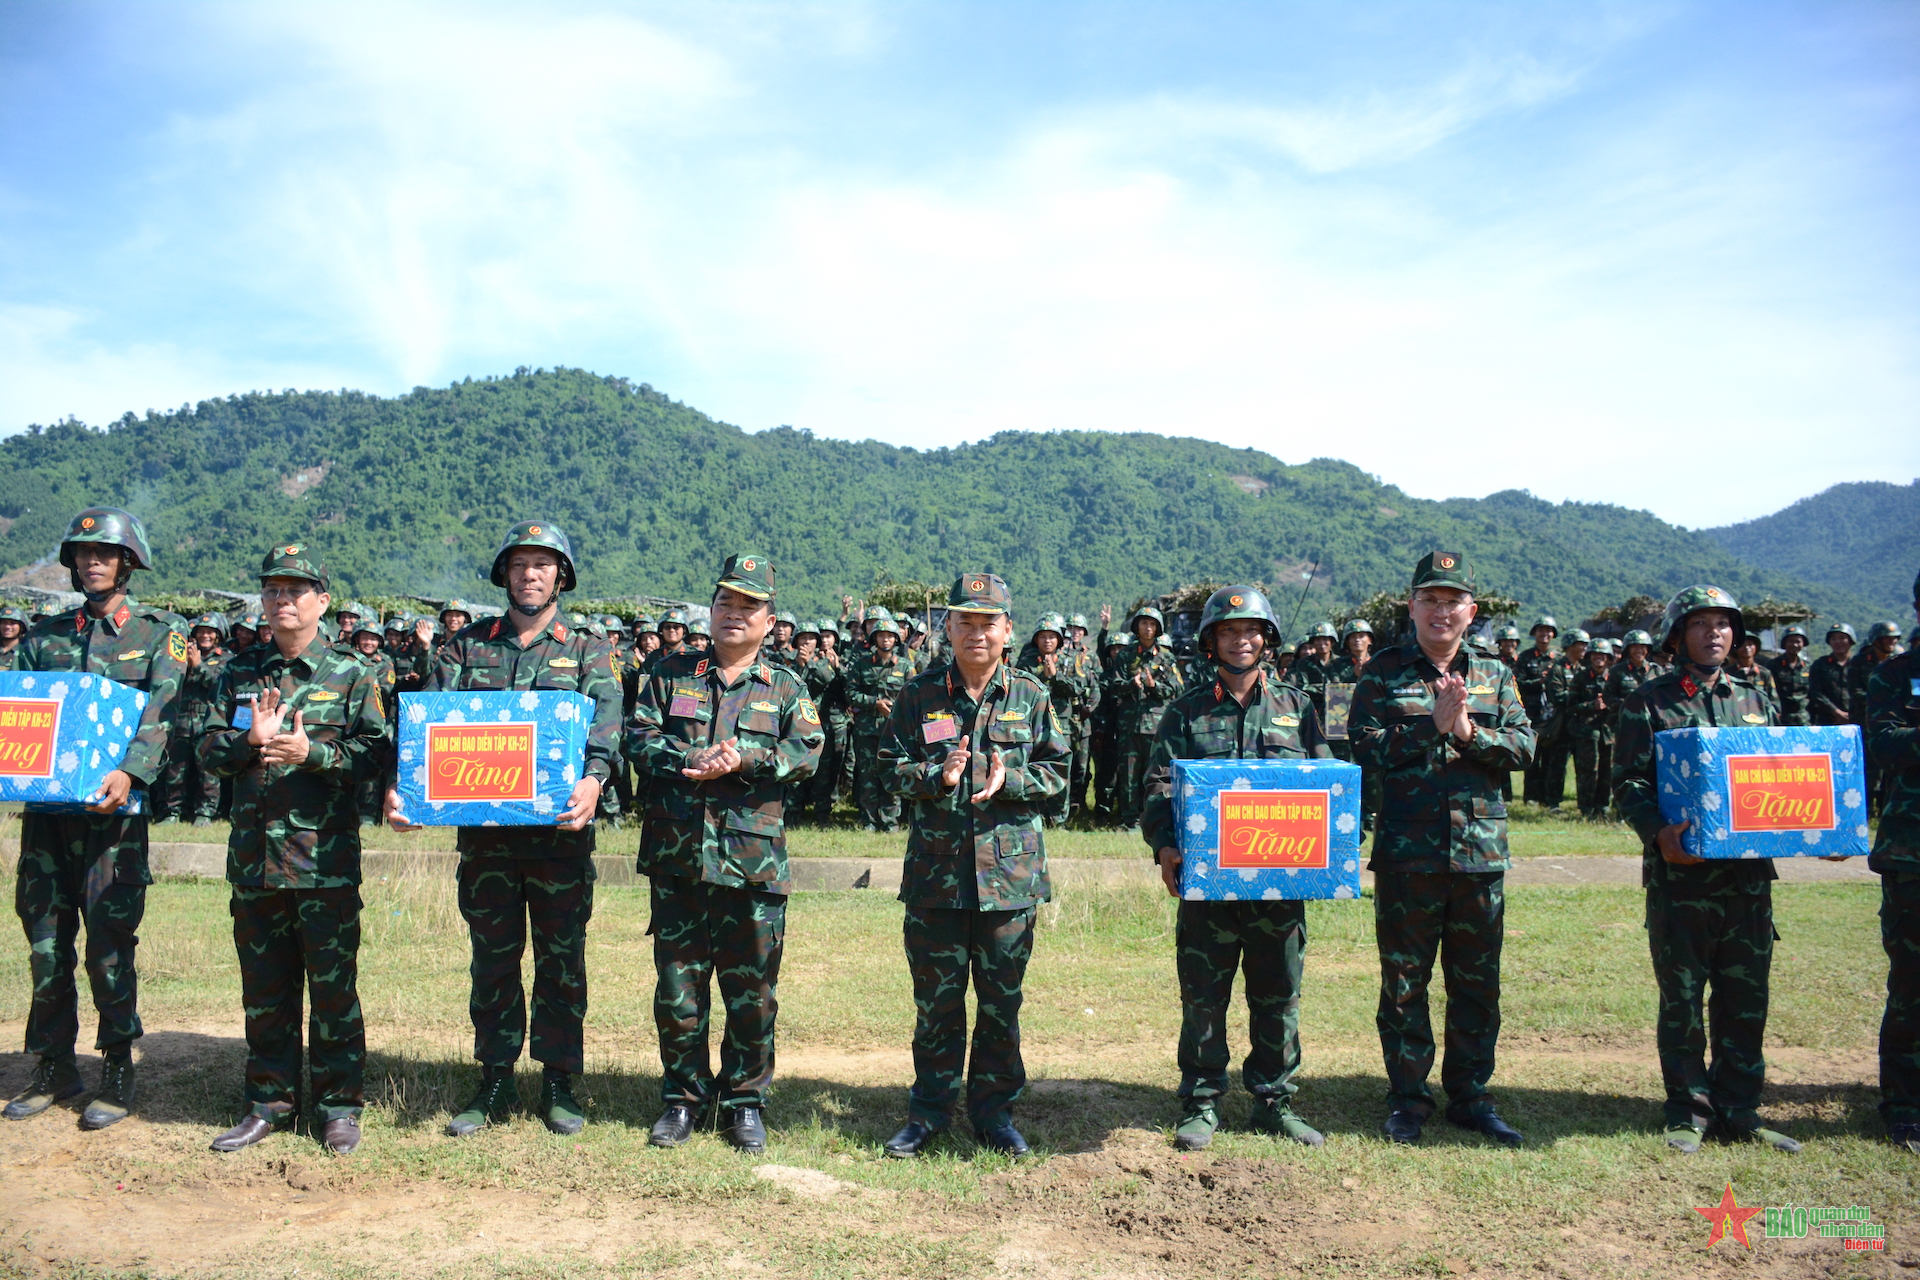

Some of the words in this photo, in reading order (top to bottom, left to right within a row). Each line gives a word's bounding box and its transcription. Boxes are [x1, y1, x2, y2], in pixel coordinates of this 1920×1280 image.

[1, 706, 18, 727] DIỄN
[18, 708, 32, 731] TẬP
[31, 711, 52, 728] KH-23
[434, 736, 448, 752] BAN
[451, 732, 461, 752] CHỈ
[461, 736, 476, 755] ĐẠO
[477, 730, 493, 752] DIỄN
[493, 733, 507, 755] TẬP
[507, 735, 528, 752] KH-23
[438, 757, 523, 793] Tặng
[1735, 769, 1749, 784] BAN
[1750, 764, 1761, 783] CHỈ
[1761, 769, 1776, 786] ĐẠO
[1777, 763, 1793, 783] DIỄN
[1793, 765, 1805, 785] TẬP
[1806, 767, 1826, 782] KH-23
[1226, 805, 1240, 820] BAN
[1242, 800, 1254, 820] CHỈ
[1254, 805, 1269, 823] ĐẠO
[1269, 800, 1286, 820] DIỄN
[1287, 802, 1301, 823] TẬP
[1301, 805, 1322, 820] KH-23
[1741, 789, 1823, 824] Tặng
[1230, 826, 1317, 862] Tặng
